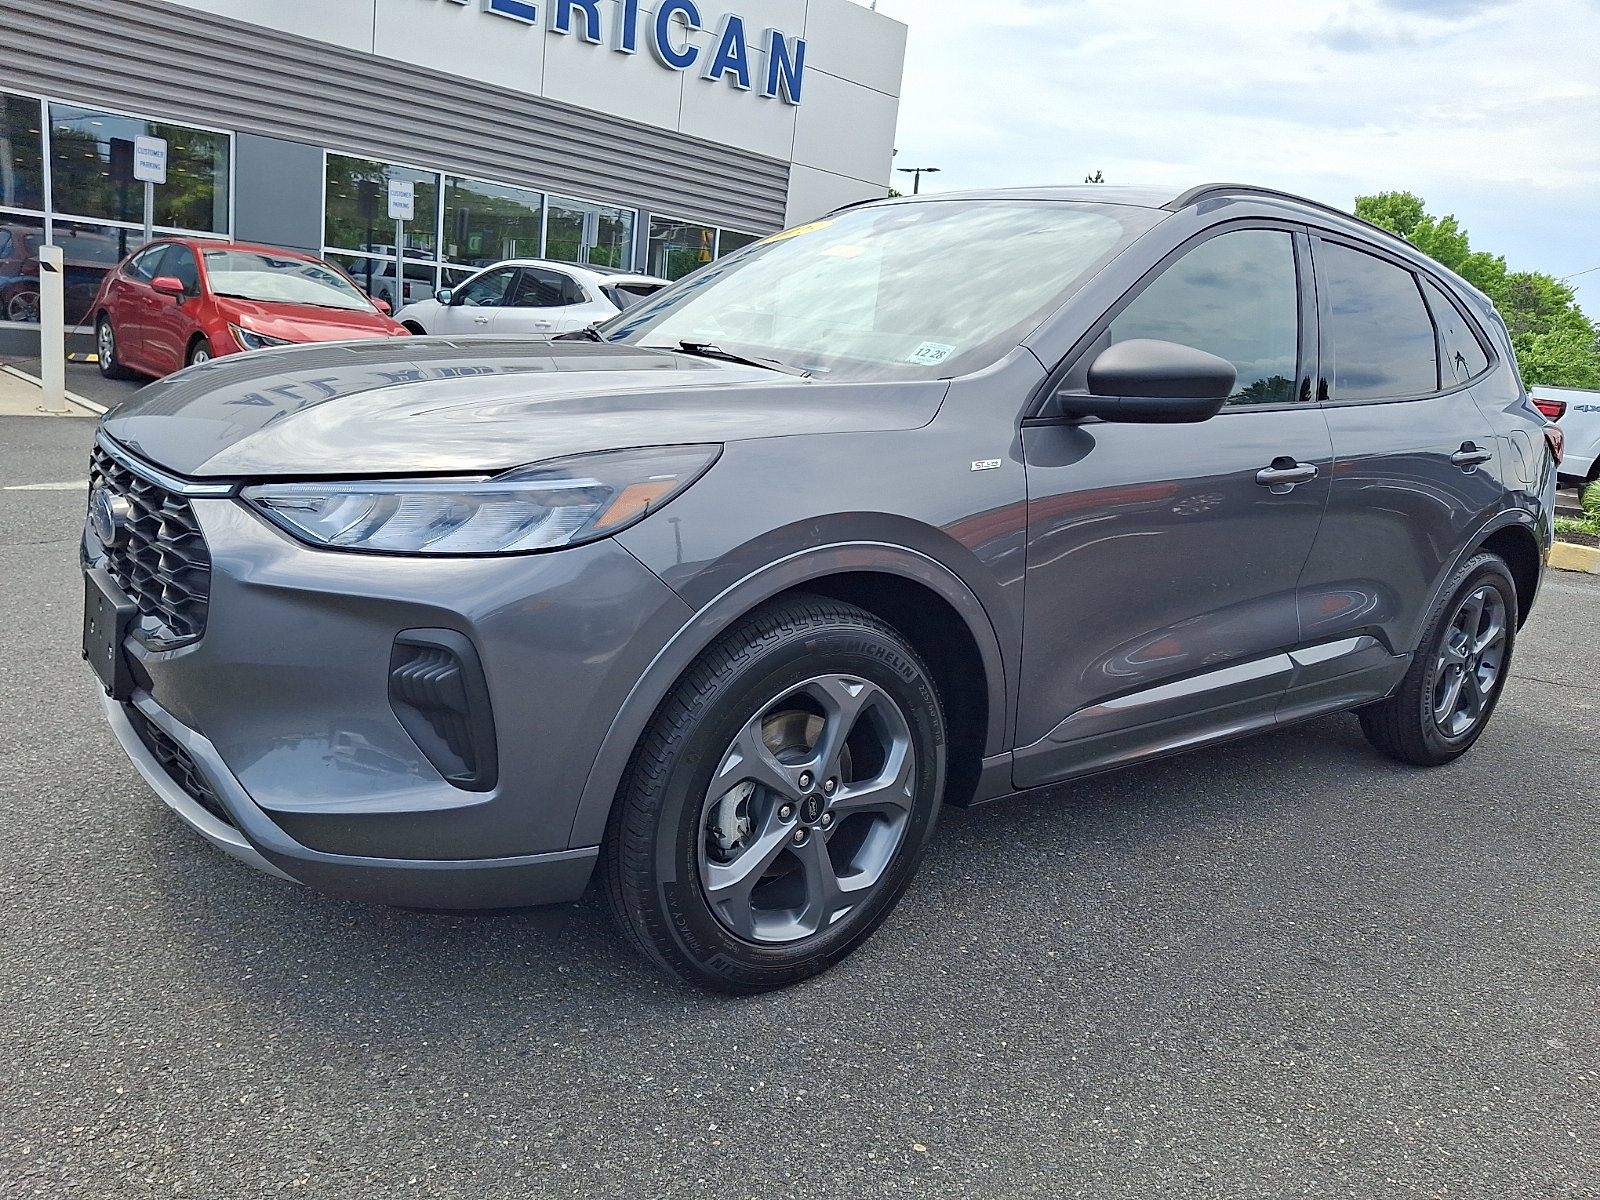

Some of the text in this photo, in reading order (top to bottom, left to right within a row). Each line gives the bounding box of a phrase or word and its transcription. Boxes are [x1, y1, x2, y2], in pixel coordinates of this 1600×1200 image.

[446, 0, 807, 106] RICAN
[913, 347, 931, 357] 12
[846, 640, 915, 680] MICHELIN
